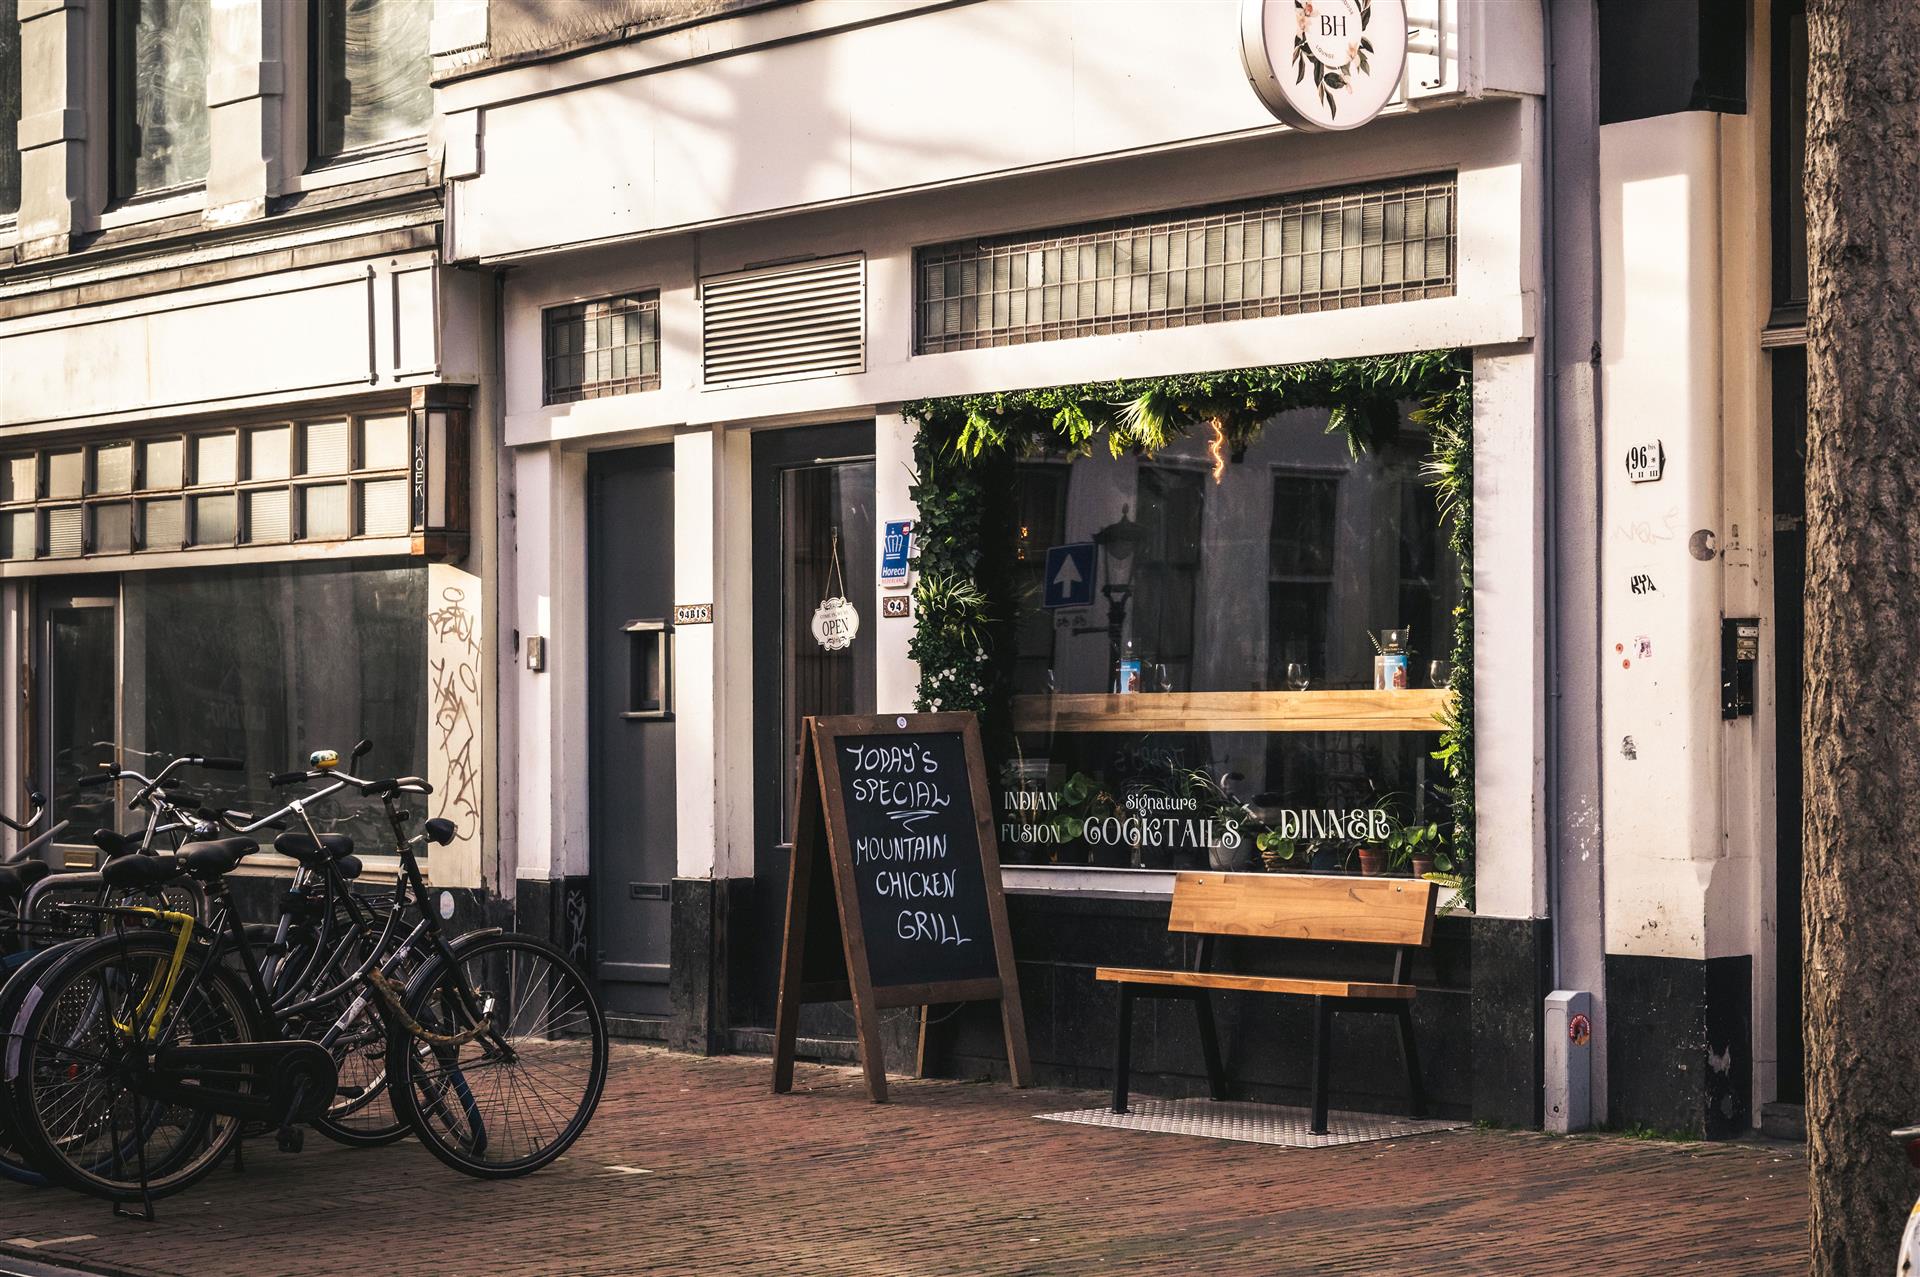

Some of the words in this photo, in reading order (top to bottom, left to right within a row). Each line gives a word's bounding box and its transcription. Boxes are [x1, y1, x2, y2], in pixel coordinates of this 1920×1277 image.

[1321, 15, 1346, 36] BH
[1631, 446, 1648, 469] 96
[415, 445, 424, 497] KOEK
[882, 567, 905, 577] Horeca
[679, 609, 706, 619] 94BIS
[889, 602, 902, 612] 94
[822, 618, 849, 636] OPEN
[846, 742, 938, 773] TODAY'S
[853, 779, 950, 808] SPECIAL
[1004, 791, 1058, 811] INDIAN
[1125, 793, 1197, 817] Signature
[1001, 823, 1061, 843] FUSION
[1083, 816, 1242, 849] COCKTAILS
[1280, 808, 1390, 839] DINNER
[856, 834, 947, 866] MOUNTAIN
[876, 868, 957, 900] CHICKEN
[897, 910, 972, 946] GRILL
